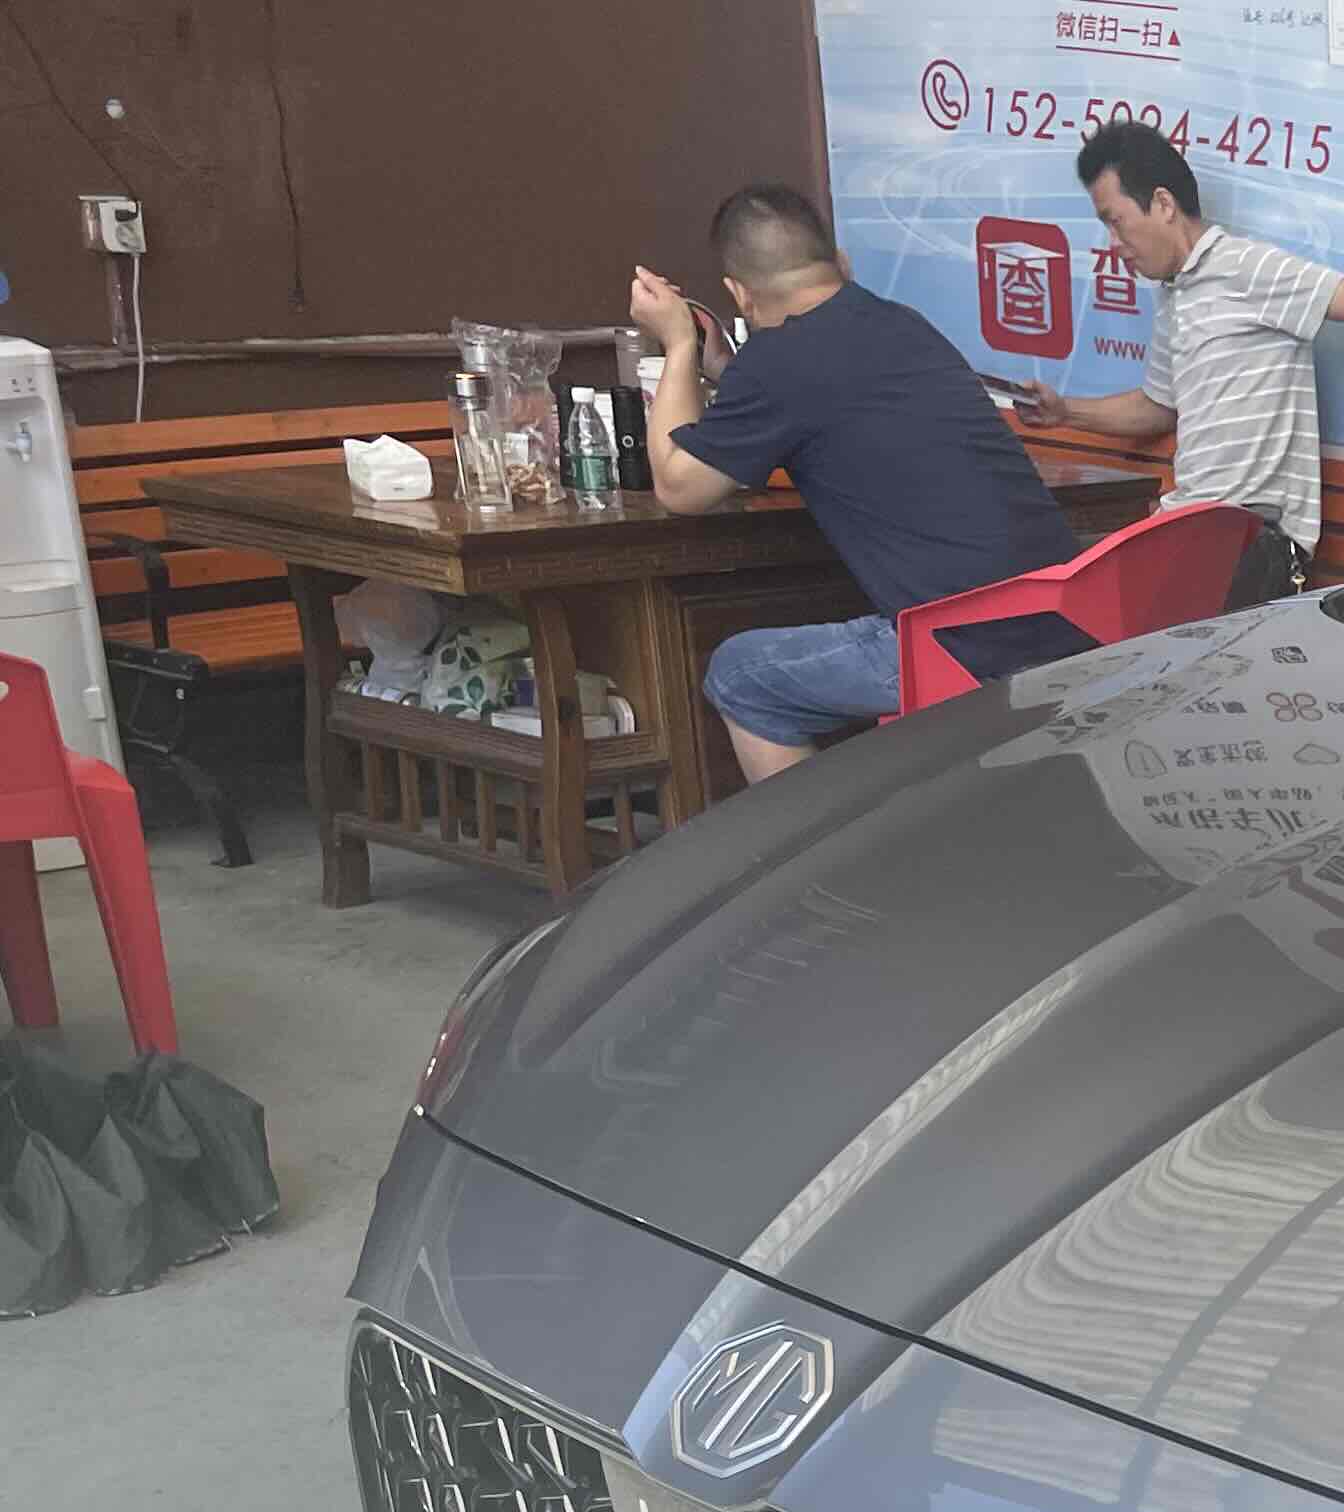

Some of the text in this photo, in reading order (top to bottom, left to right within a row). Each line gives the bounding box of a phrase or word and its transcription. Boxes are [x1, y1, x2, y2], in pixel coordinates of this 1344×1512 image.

[1056, 11, 1163, 48] 微信扫一扫
[690, 1338, 817, 1458] MG
